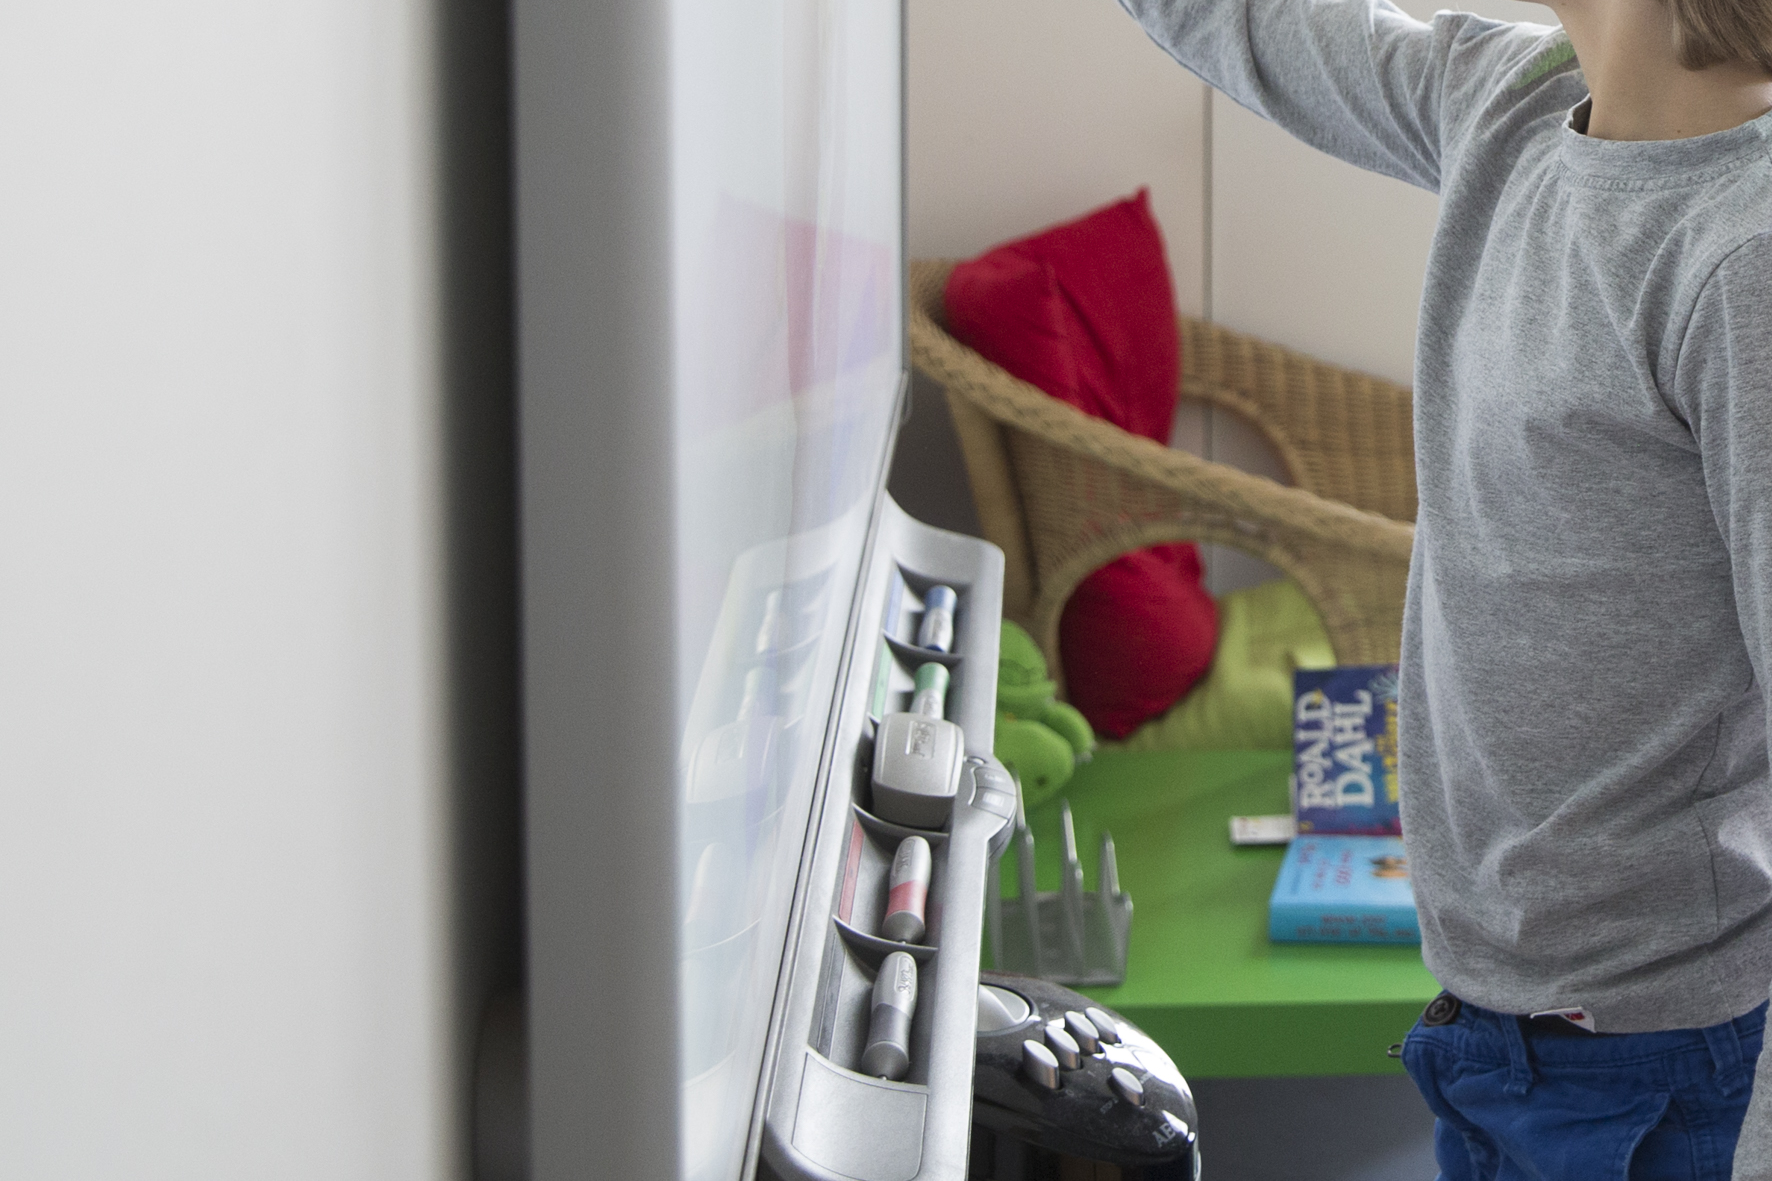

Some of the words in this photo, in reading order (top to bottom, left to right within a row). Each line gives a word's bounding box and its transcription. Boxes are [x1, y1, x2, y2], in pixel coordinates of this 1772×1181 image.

[1297, 690, 1336, 809] ROALD
[1333, 689, 1374, 809] DAHL
[1152, 1121, 1178, 1148] AE
